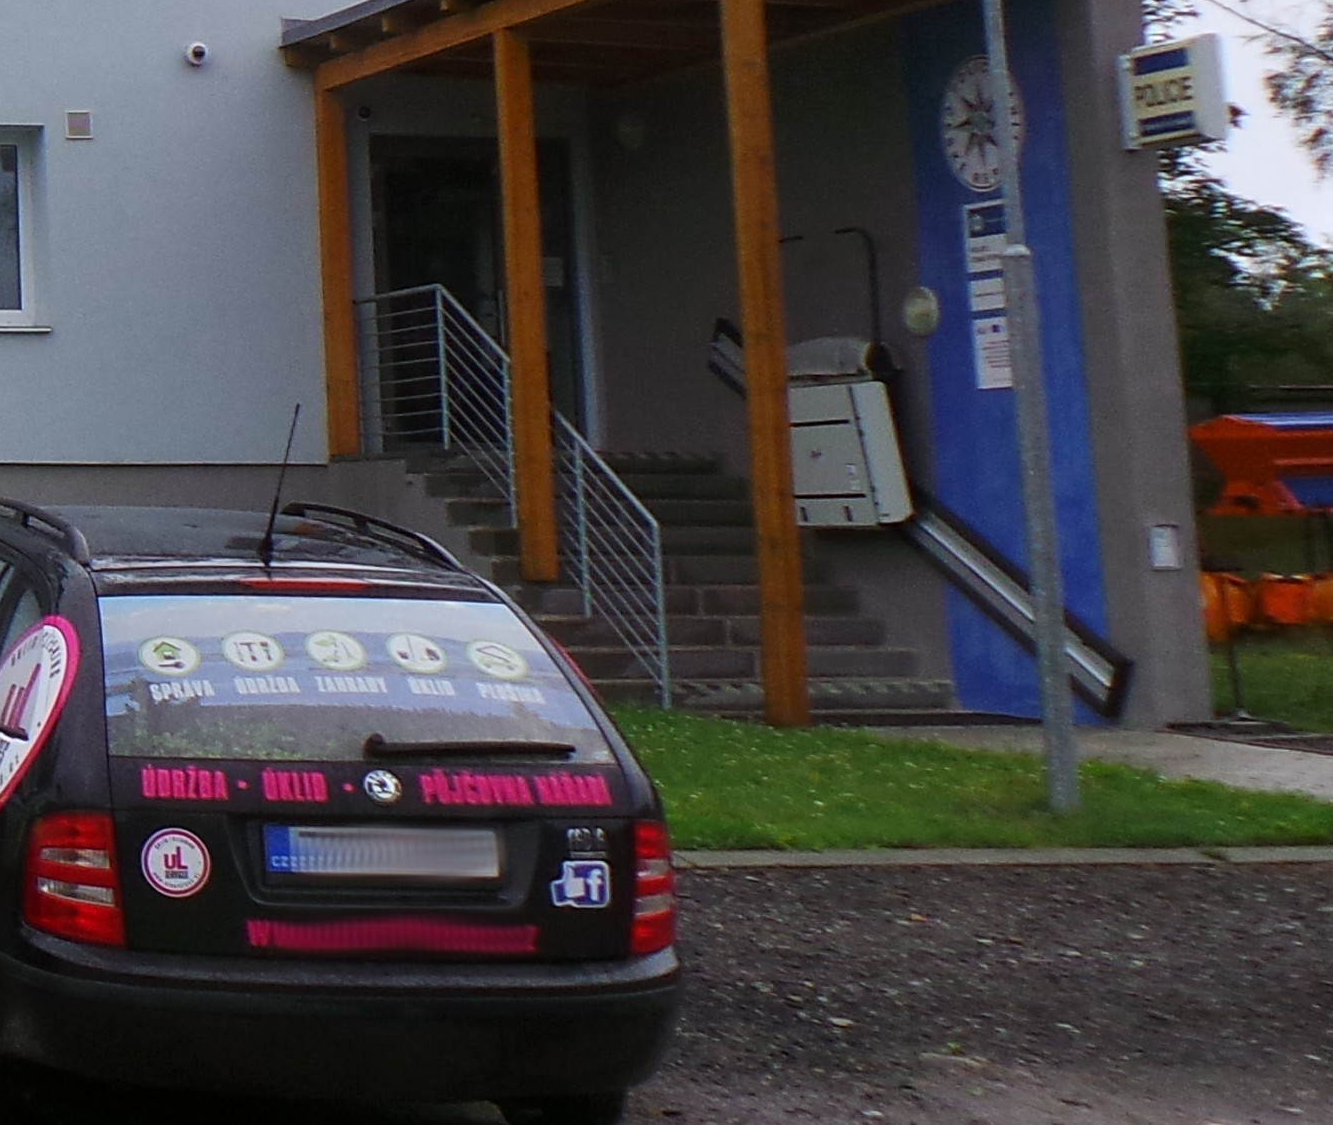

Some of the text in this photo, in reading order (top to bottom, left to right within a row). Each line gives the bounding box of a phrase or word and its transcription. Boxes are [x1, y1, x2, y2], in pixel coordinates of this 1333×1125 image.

[148, 679, 216, 703] SPRÁVA
[142, 763, 229, 799] ÚDRŽBA
[262, 767, 329, 802] ÚKLID
[419, 767, 534, 805] PŮJČOVNA
